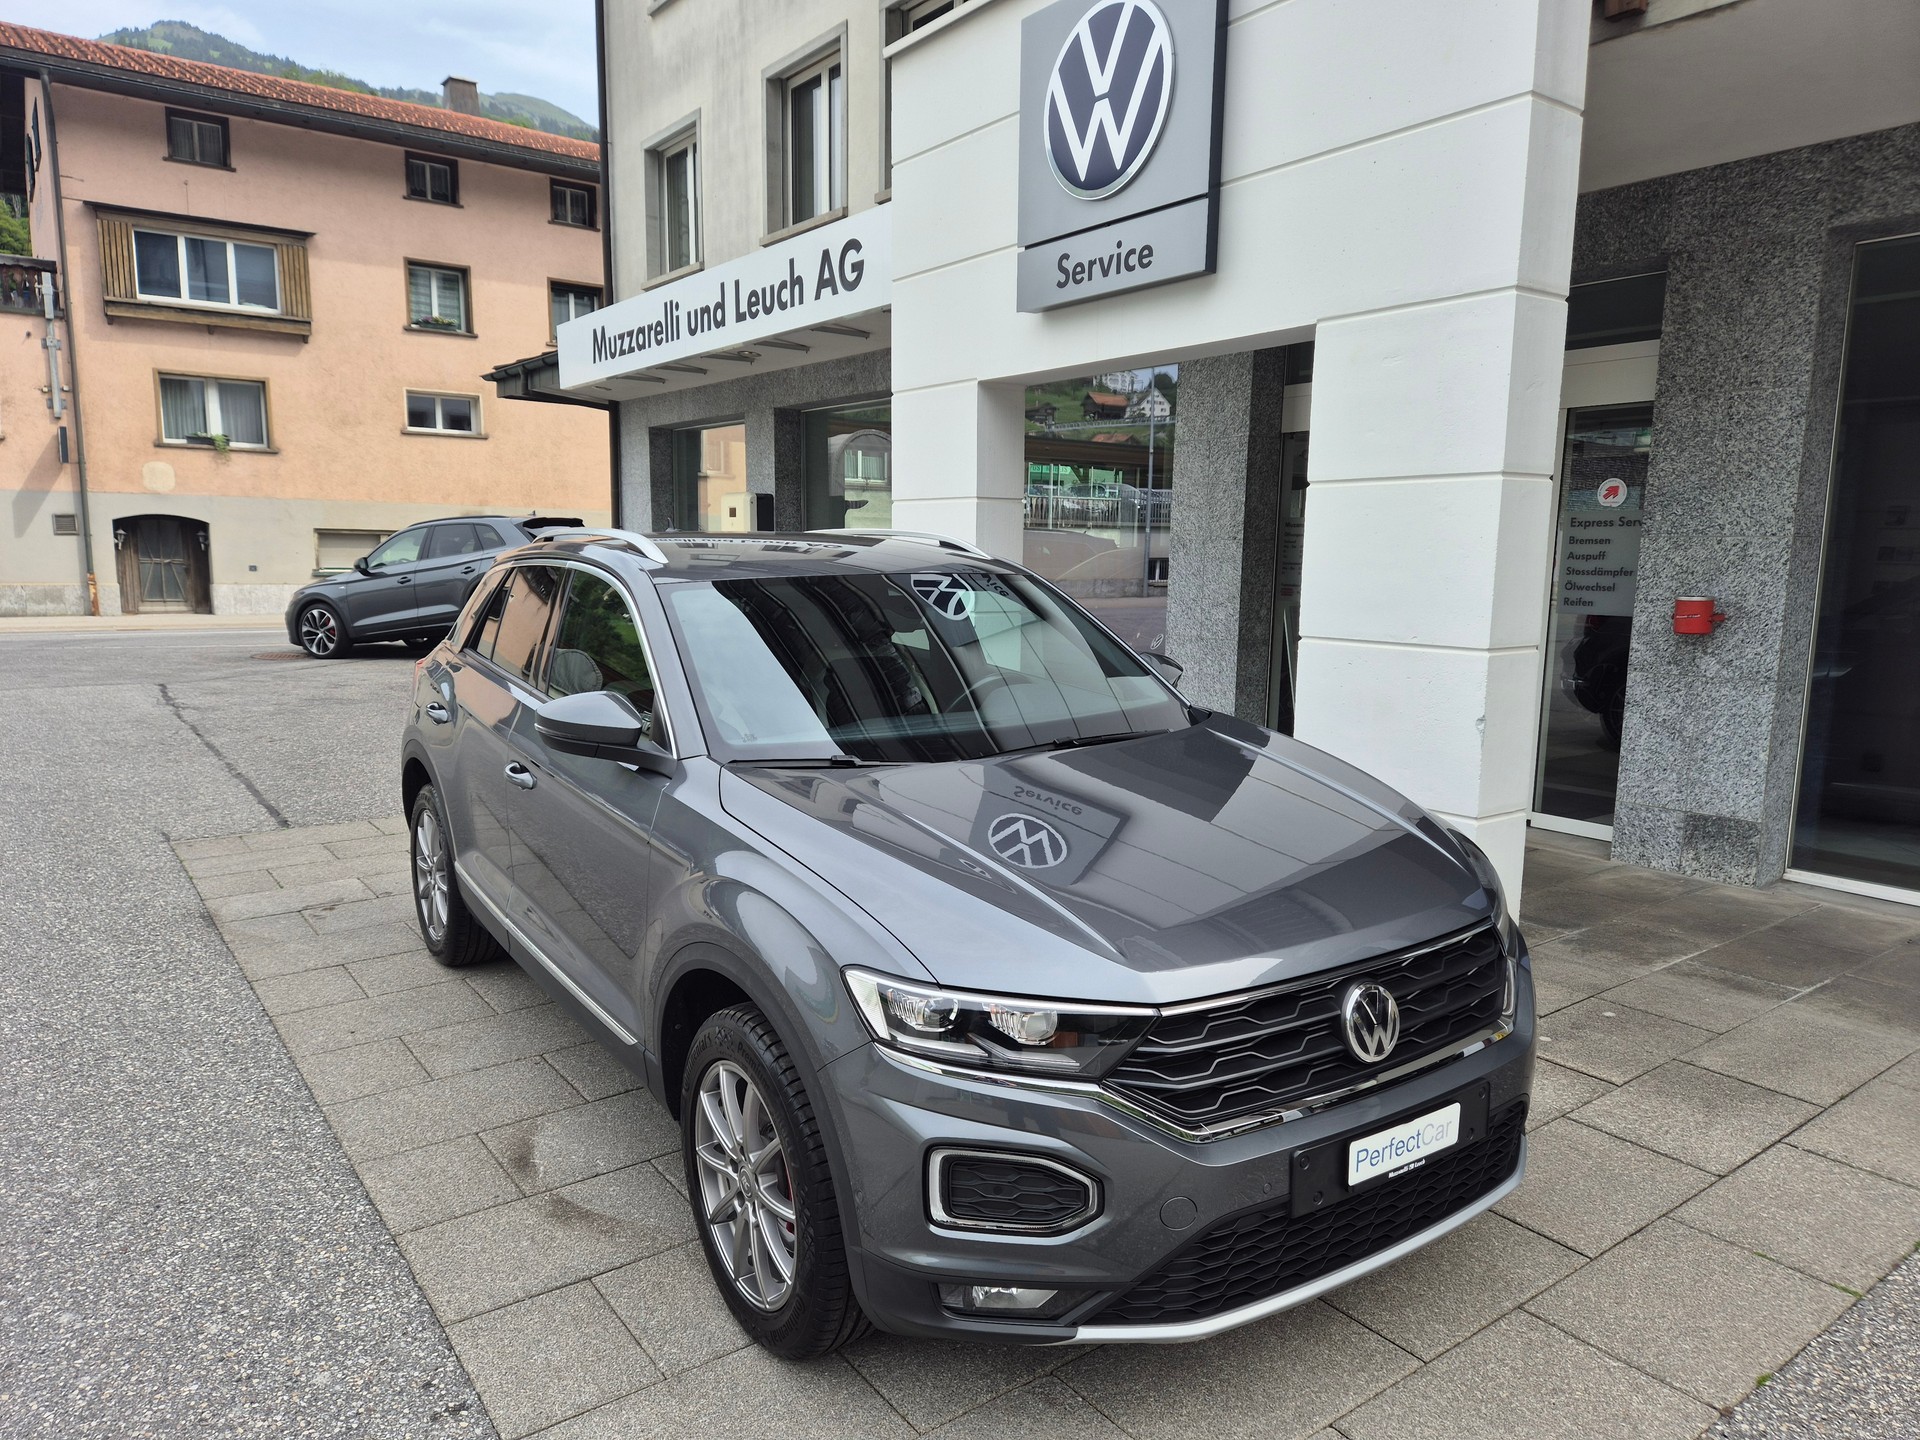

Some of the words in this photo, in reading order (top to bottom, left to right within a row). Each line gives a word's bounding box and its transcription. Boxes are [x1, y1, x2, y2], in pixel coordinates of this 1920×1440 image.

[1056, 240, 1154, 289] Service
[592, 299, 680, 364] Muzzarelli
[687, 281, 726, 337] und
[734, 257, 804, 324] Leuch
[814, 238, 865, 301] AG
[1570, 517, 1614, 530] Express
[1568, 536, 1611, 545] Bremsen
[1567, 551, 1606, 562] Auspuff
[1566, 566, 1634, 578] Stossdämpfer
[1564, 580, 1616, 592] Ölwechsel
[1563, 597, 1594, 607] Reifen
[1355, 1120, 1452, 1173] PerfectCar
